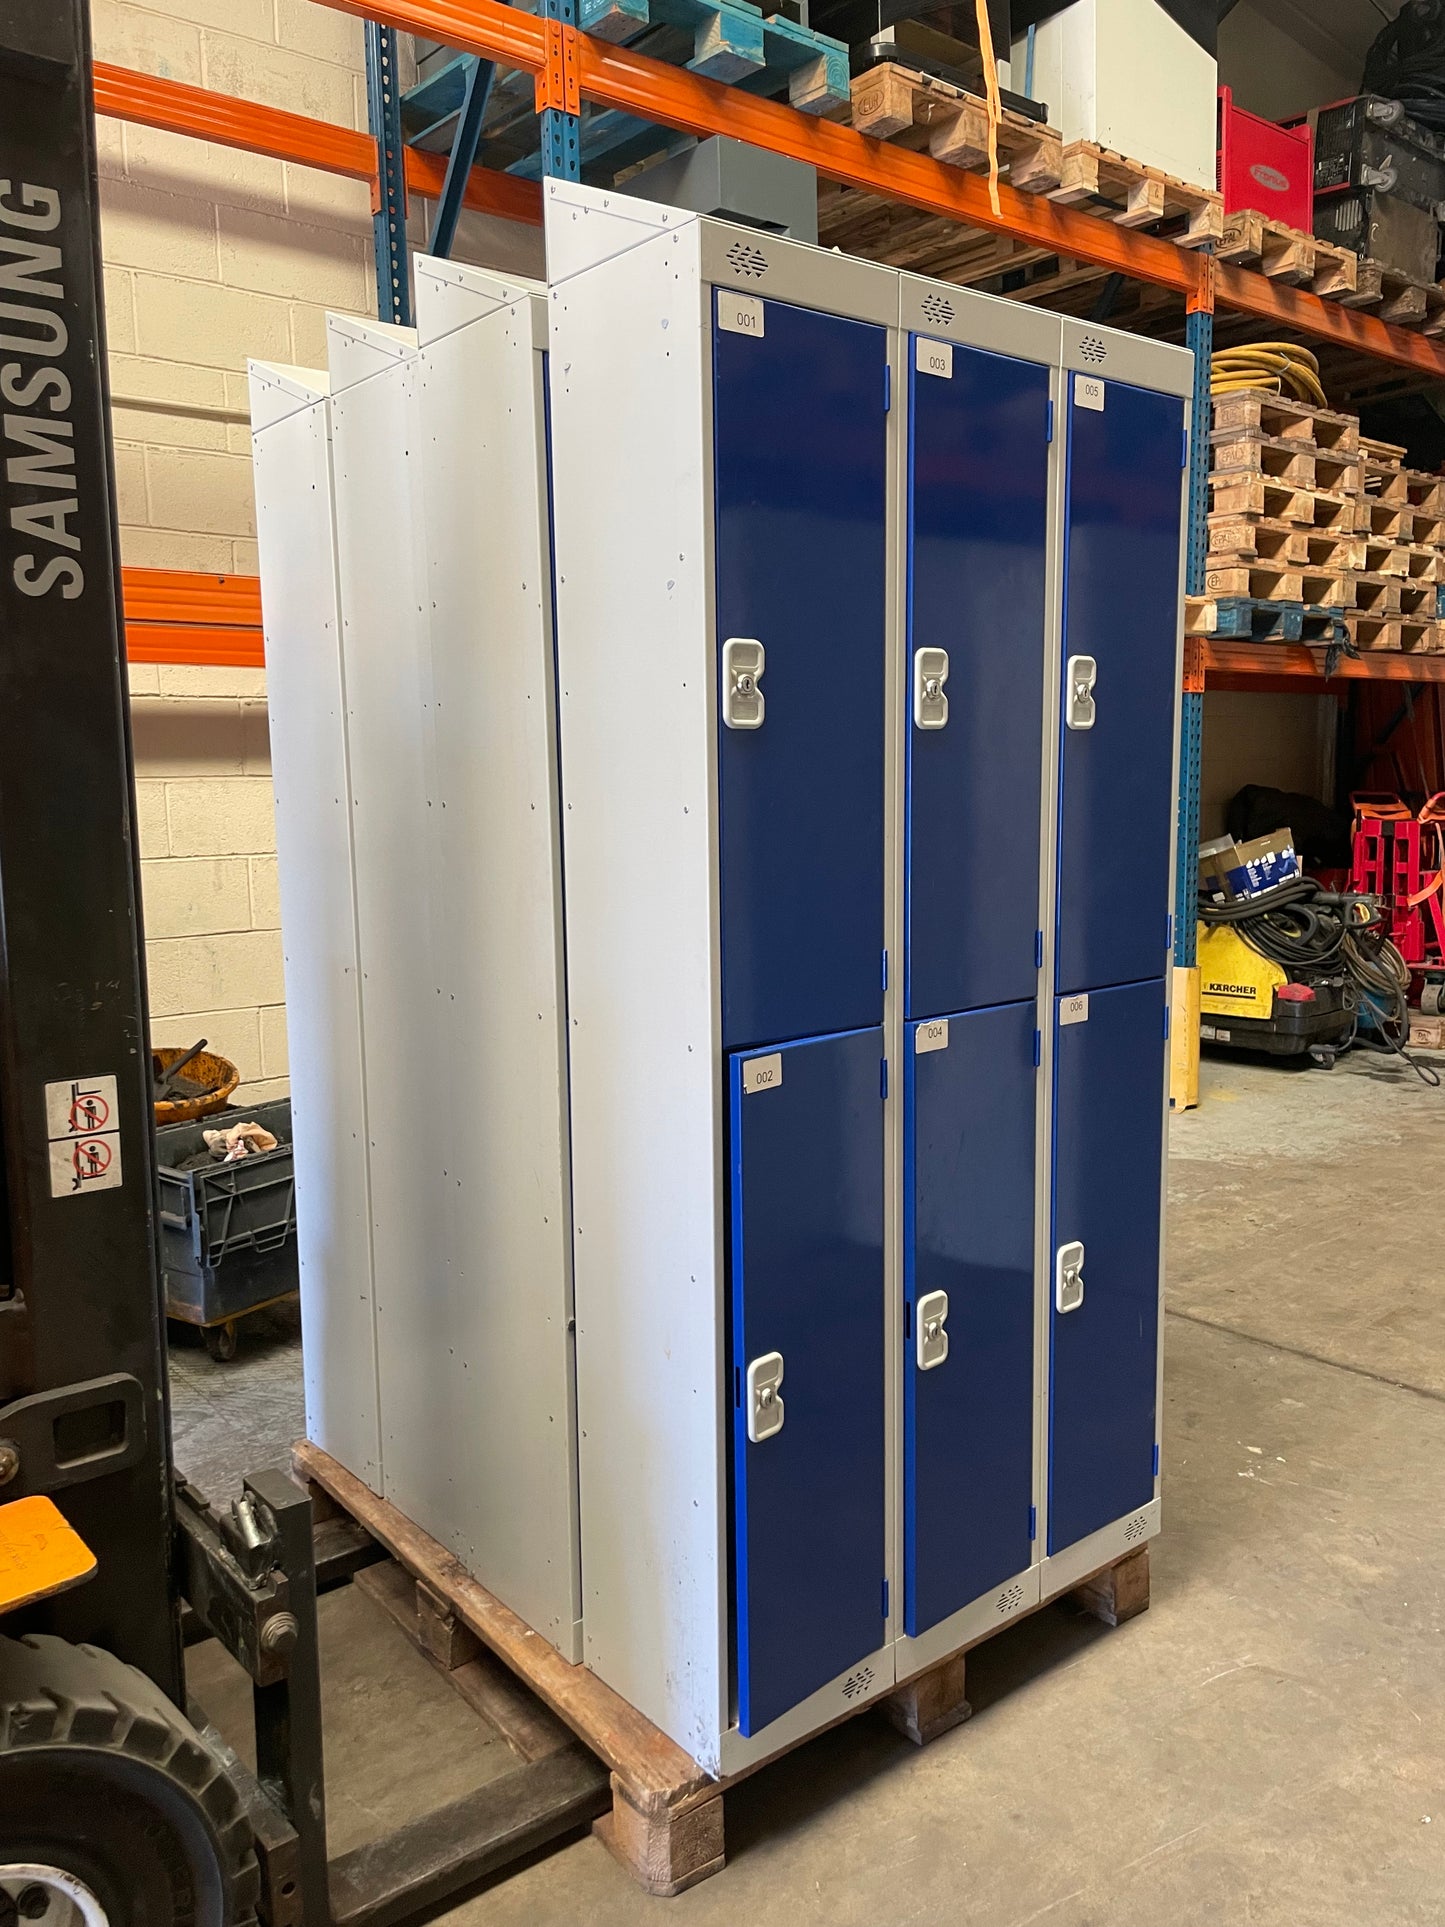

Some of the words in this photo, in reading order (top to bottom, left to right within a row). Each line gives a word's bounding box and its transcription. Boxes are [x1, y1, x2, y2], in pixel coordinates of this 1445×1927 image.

[737, 312, 756, 329] 001
[929, 356, 946, 371] 003
[0, 178, 84, 600] SAMSUNG
[1085, 384, 1099, 397] 005
[1070, 1000, 1083, 1012] 006
[927, 1026, 943, 1039] 004
[756, 1070, 773, 1084] 002
